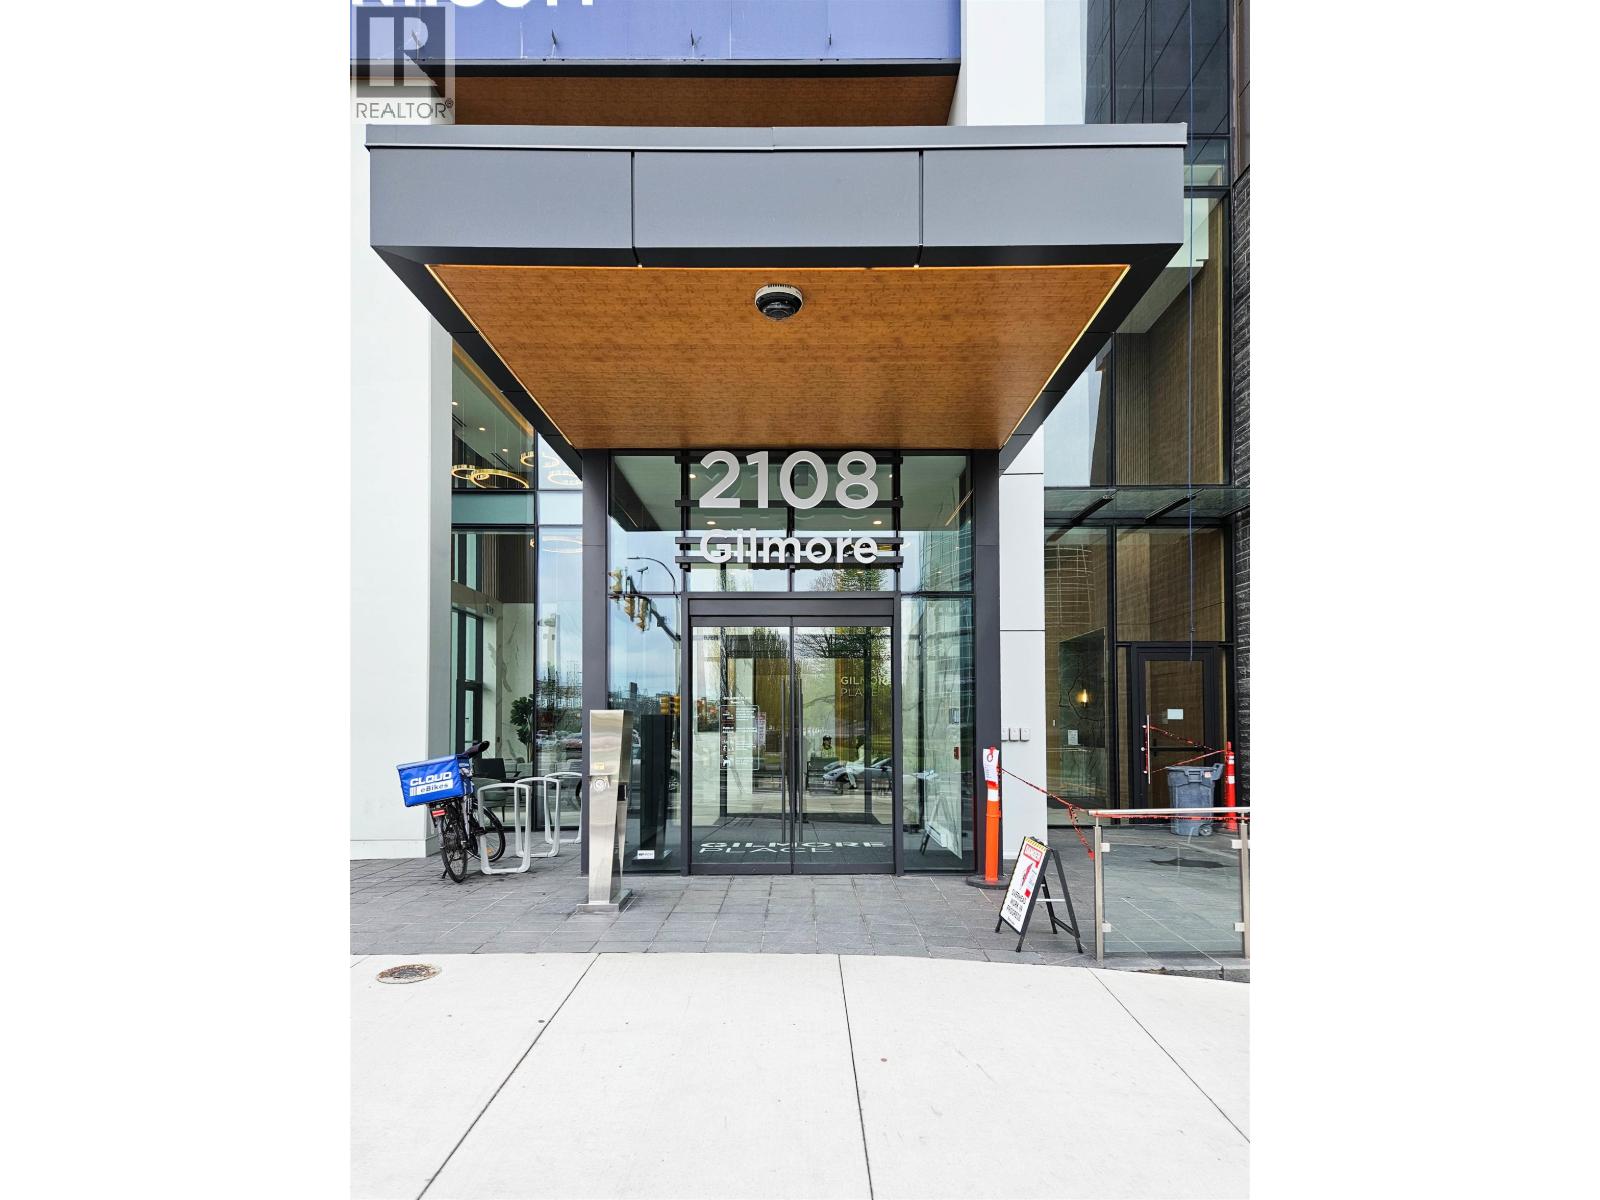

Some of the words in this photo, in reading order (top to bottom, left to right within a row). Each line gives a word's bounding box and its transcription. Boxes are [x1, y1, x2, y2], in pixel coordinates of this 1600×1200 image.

[699, 450, 879, 509] 2108
[699, 528, 878, 564] Gilmore
[840, 687, 879, 697] PLAE
[410, 771, 452, 786] CLOUD
[420, 783, 449, 793] eBikes
